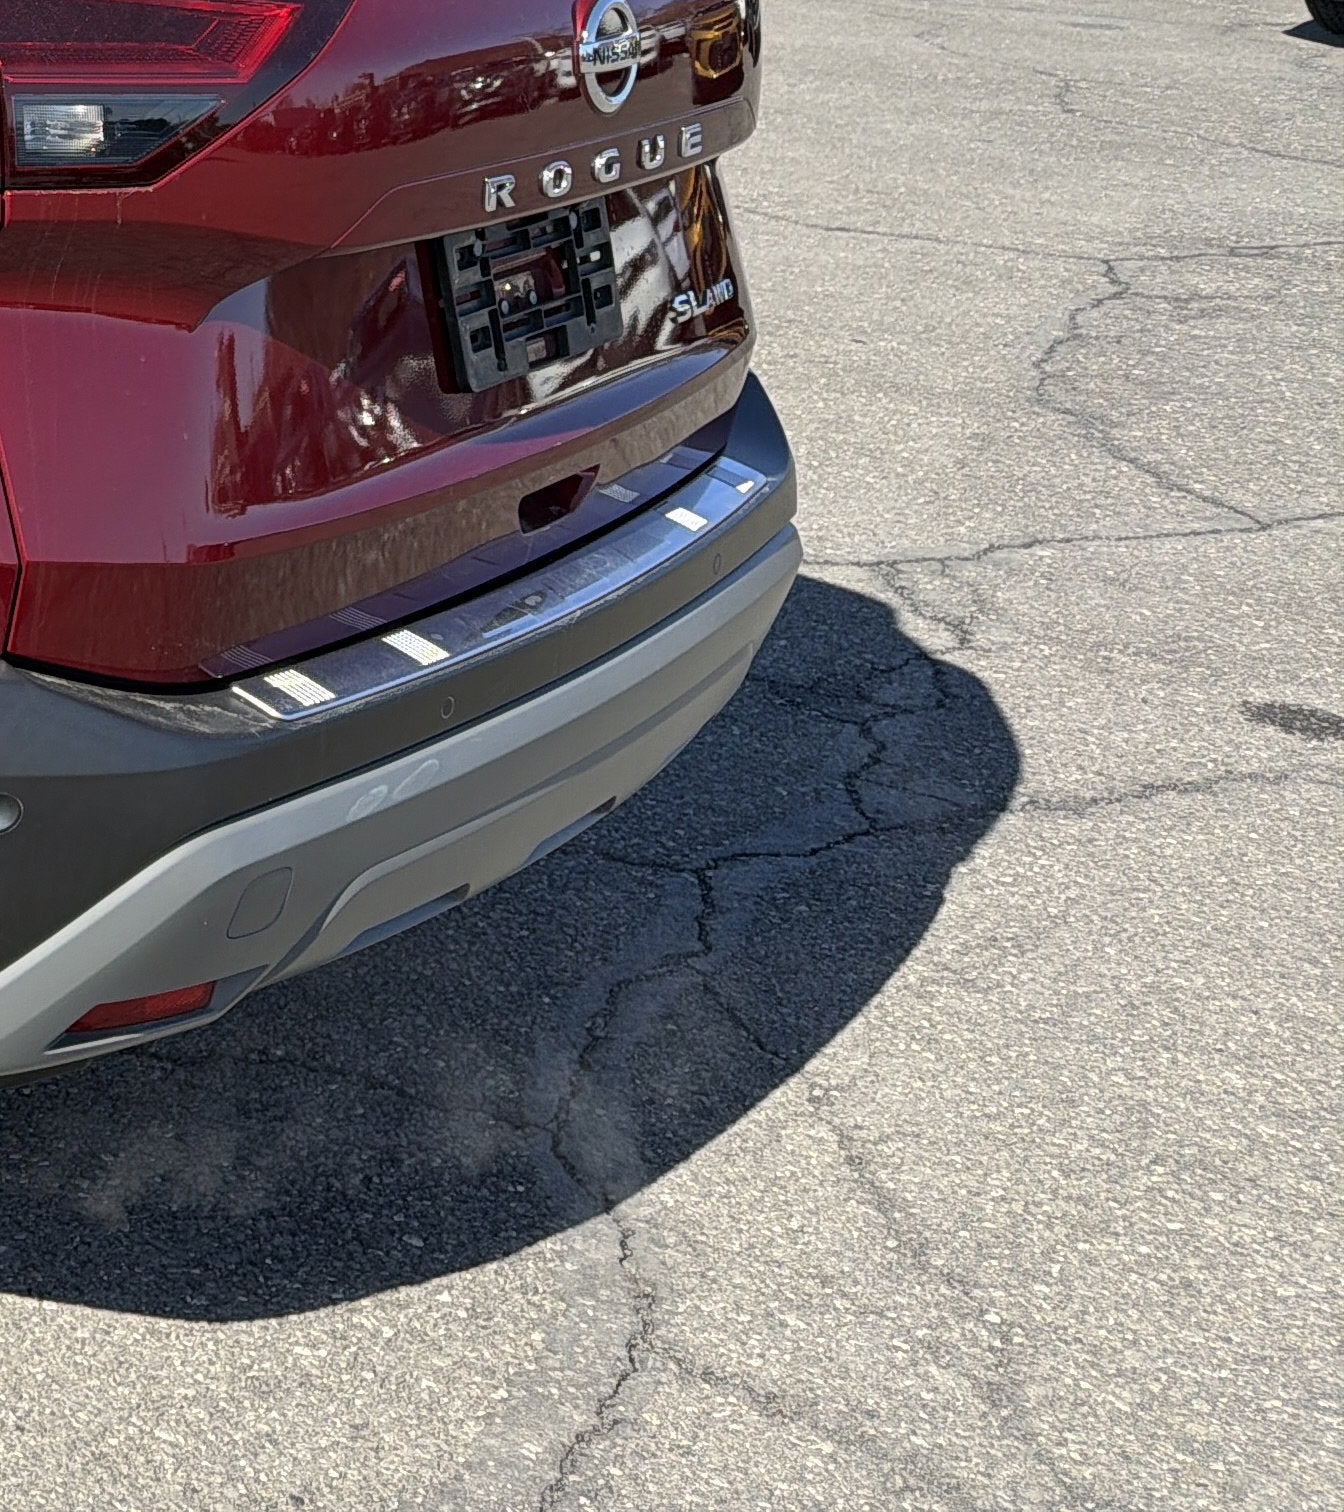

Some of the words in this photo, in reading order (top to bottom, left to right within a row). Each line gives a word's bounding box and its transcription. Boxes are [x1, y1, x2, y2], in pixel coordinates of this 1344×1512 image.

[593, 39, 641, 66] NISSAN
[483, 121, 704, 213] ROGUE
[672, 289, 713, 324] SL
